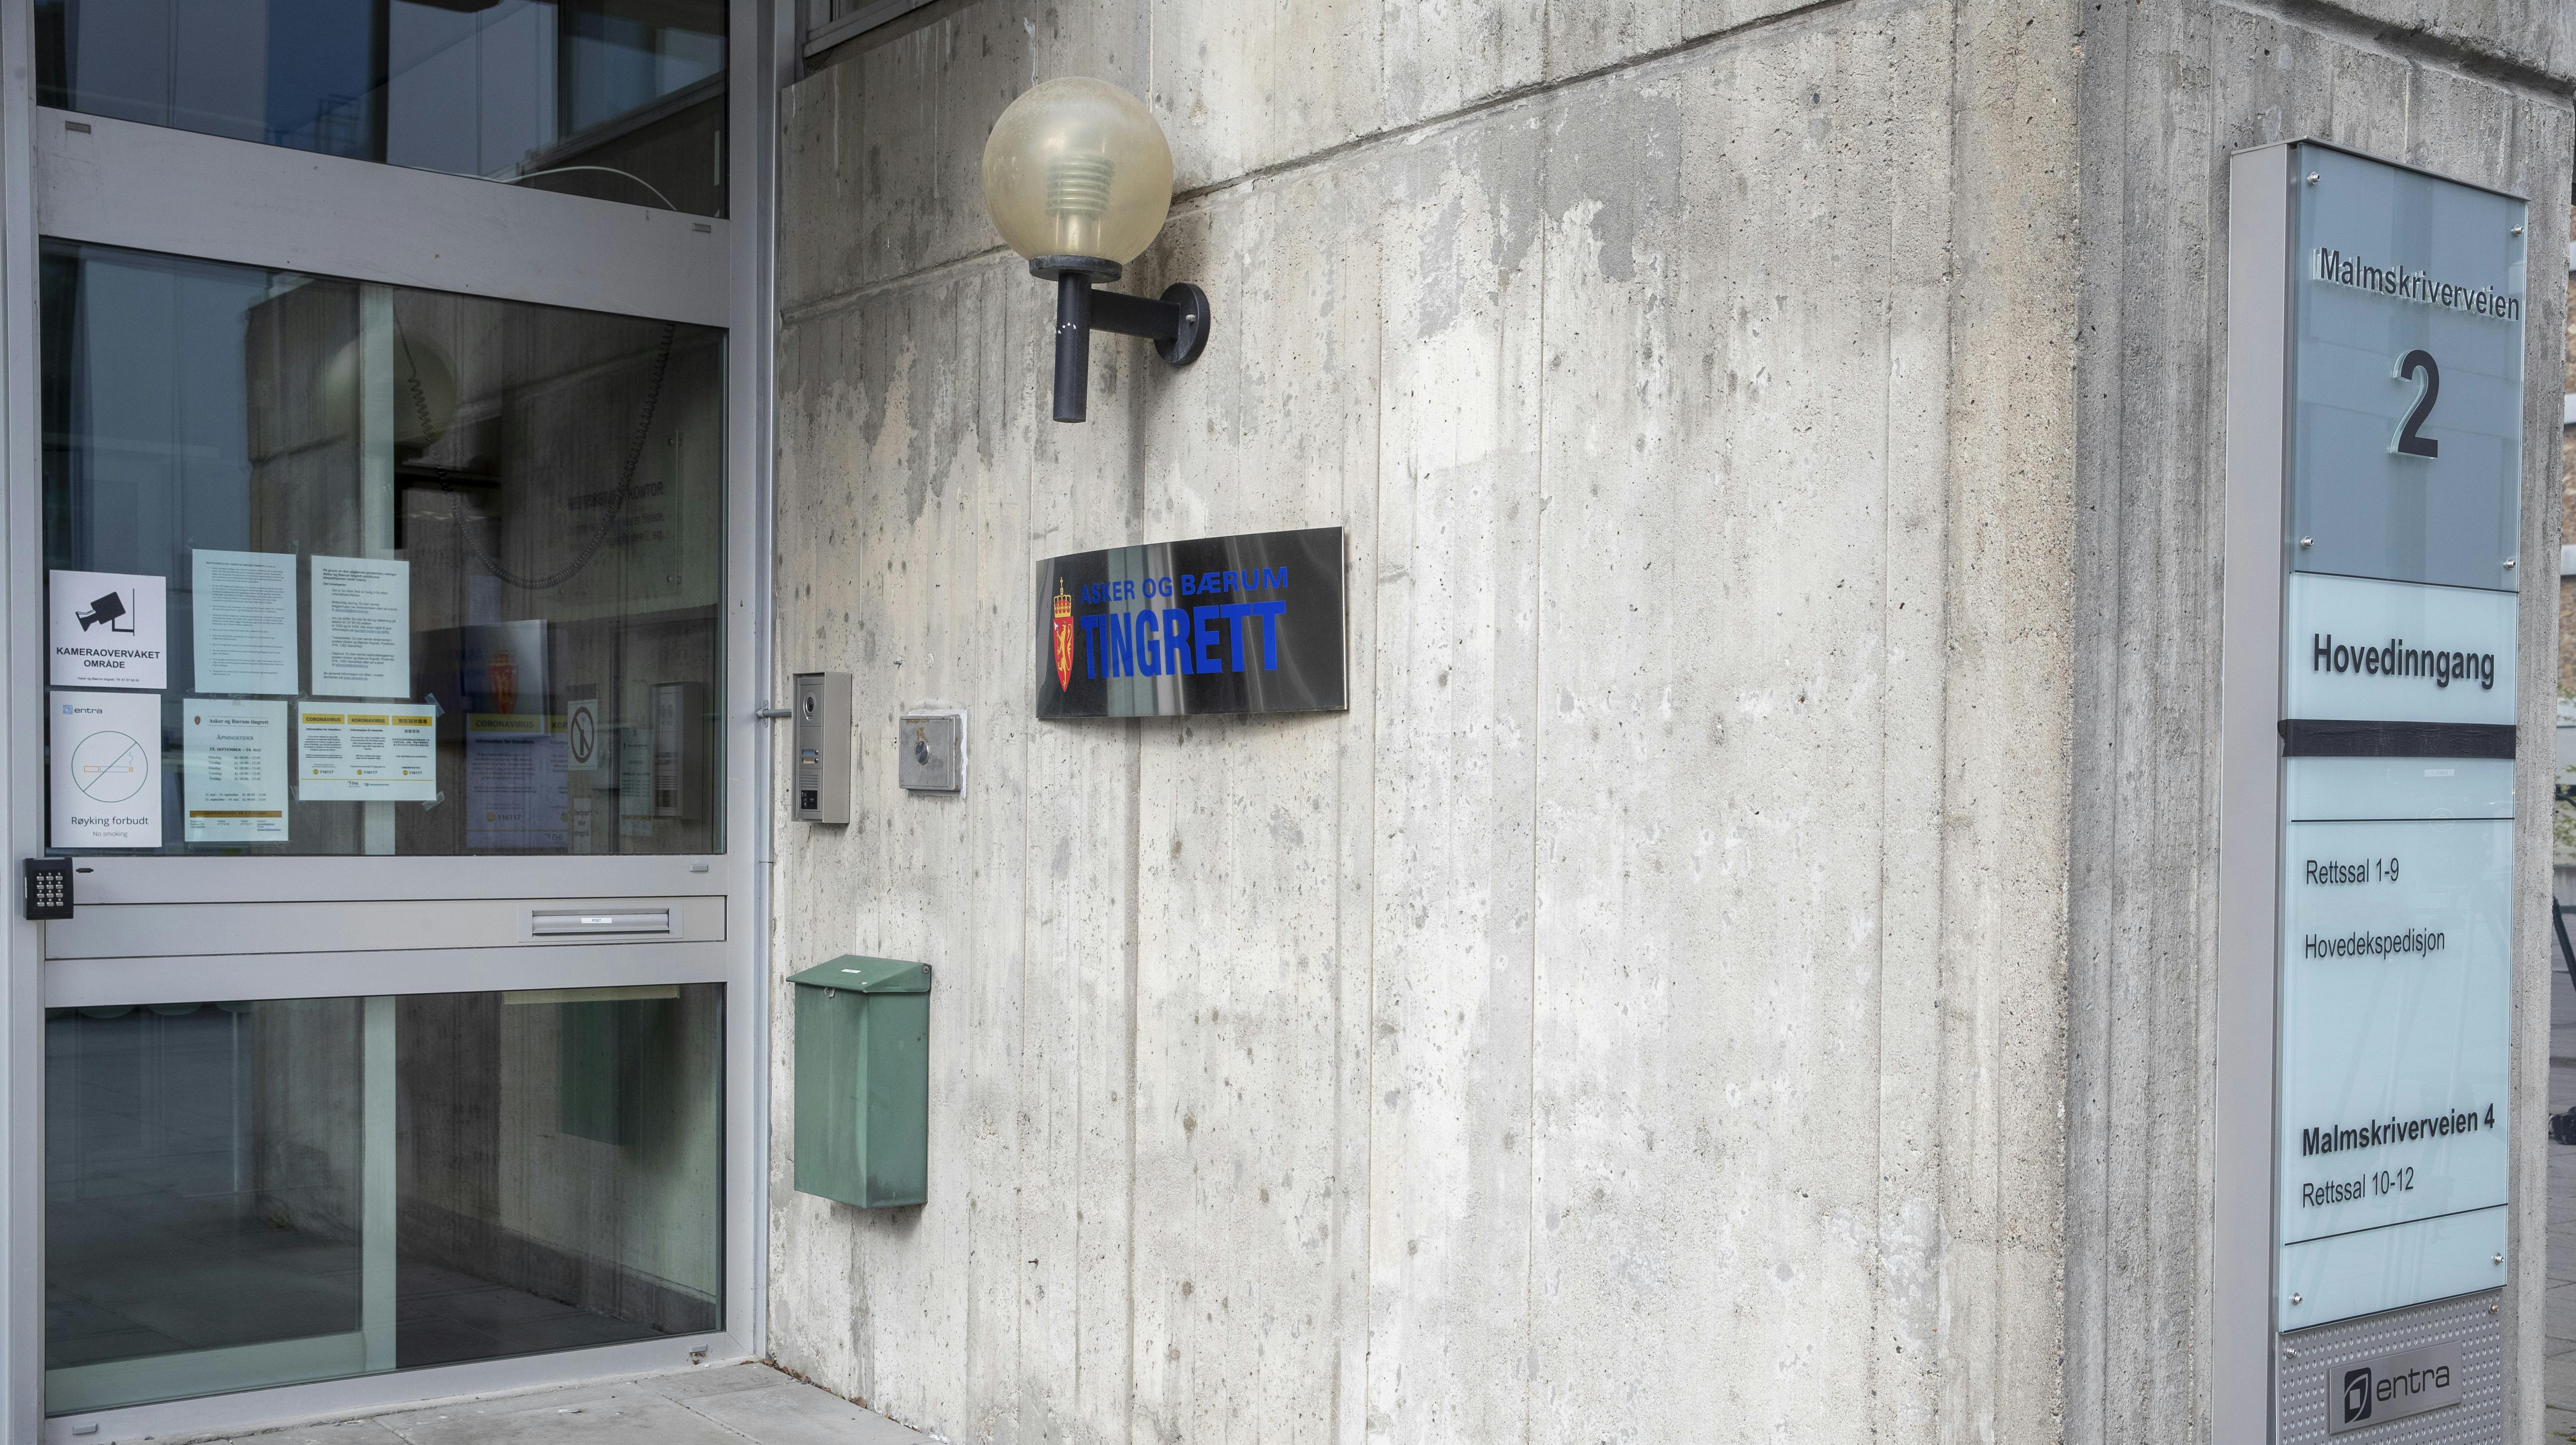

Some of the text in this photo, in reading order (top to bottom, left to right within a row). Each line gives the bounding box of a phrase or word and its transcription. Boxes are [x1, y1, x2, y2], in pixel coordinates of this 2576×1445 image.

[2317, 248, 2520, 321] Malmskriverveien
[2393, 349, 2439, 459] 2
[1080, 566, 1288, 605] ASKER OG BÆRUM
[56, 647, 161, 659] KAMERAOVERVÅKET
[1080, 600, 1286, 679] TINGRETT
[84, 660, 125, 669] OMRÅDE
[2314, 633, 2495, 690] Hovedinngang
[475, 719, 534, 728] CORONAVIRUS
[71, 815, 149, 826] Røyking forbudt
[103, 830, 128, 838] smoking
[2306, 857, 2399, 885] Rettssal 1-9
[2305, 927, 2445, 959] Hovedekspedisjon
[2302, 1103, 2495, 1156] Malmskriverveien 4
[2302, 1166, 2414, 1208] Rettssal 10-12
[2376, 1364, 2450, 1402] entra
